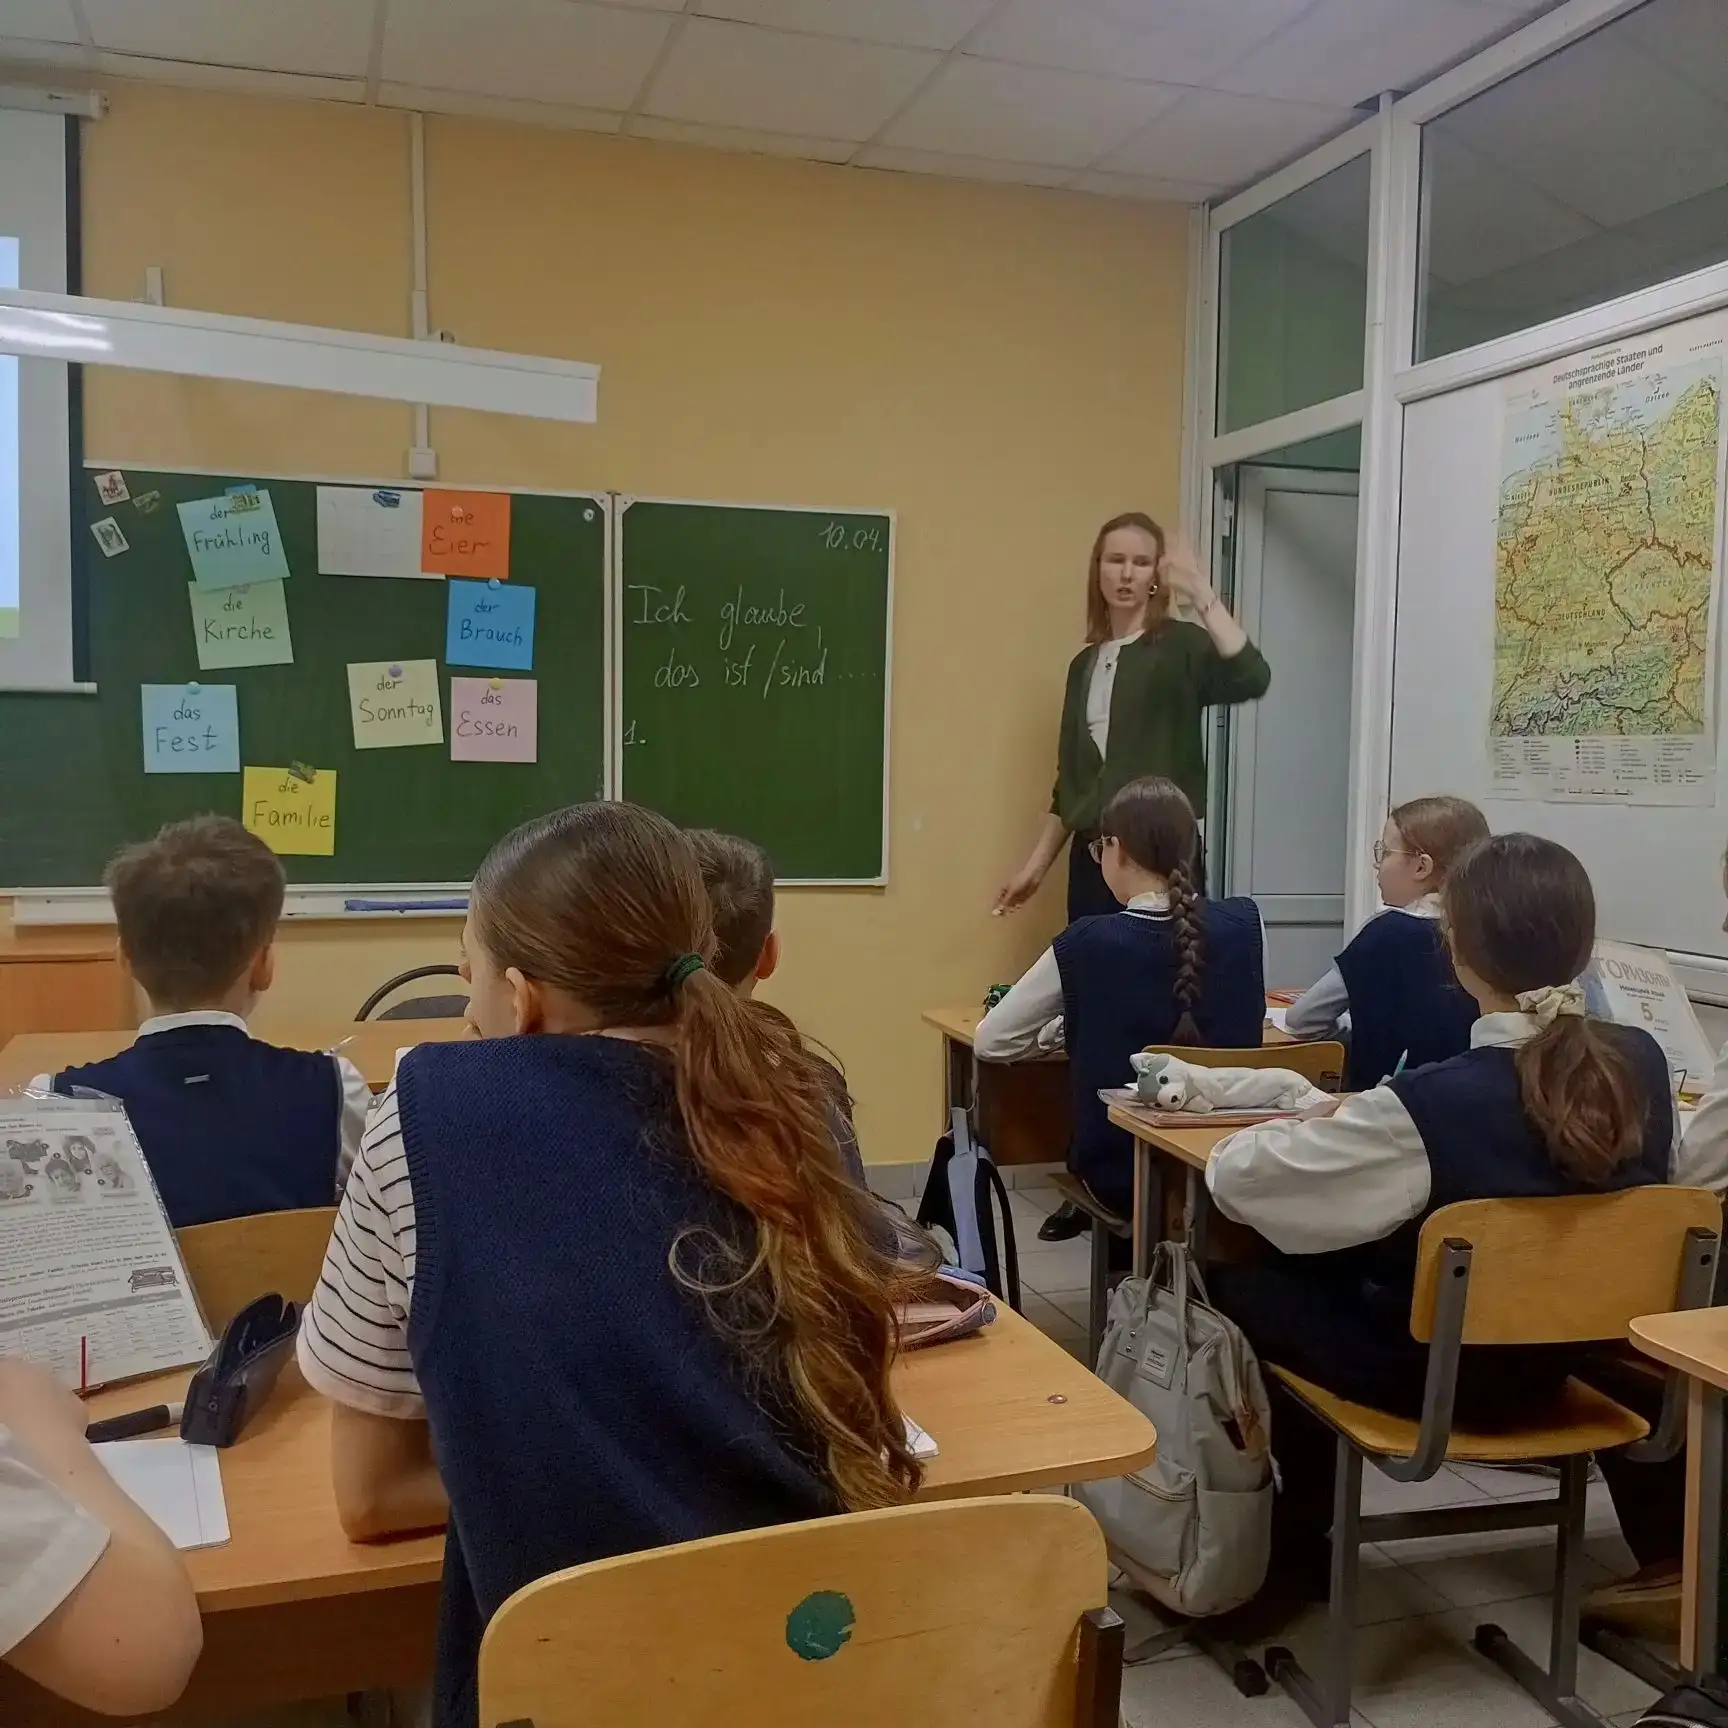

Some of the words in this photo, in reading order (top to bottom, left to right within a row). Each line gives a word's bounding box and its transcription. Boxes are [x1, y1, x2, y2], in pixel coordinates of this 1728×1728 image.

[1552, 358, 1615, 384] Deutschsprachige
[1616, 349, 1647, 365] Staaten
[1648, 344, 1663, 356] und
[1568, 368, 1616, 389] angrenzende
[1617, 361, 1645, 376] Länder
[209, 503, 231, 520] der
[193, 527, 270, 556] Frühling
[429, 525, 490, 555] Eier
[223, 592, 243, 612] die
[475, 598, 500, 614] der
[628, 583, 694, 625] Ich
[204, 616, 275, 643] Kirche
[460, 618, 523, 647] Brauch
[654, 647, 700, 688] das
[376, 675, 403, 691] der
[481, 688, 502, 706] das
[173, 699, 201, 721] das
[359, 698, 434, 727] Sonntag
[456, 710, 518, 739] Essen
[624, 719, 647, 745] 1.
[155, 725, 219, 753] Fest
[278, 776, 299, 795] die
[252, 800, 330, 829] Familie
[1640, 1001, 1654, 1022] 5
